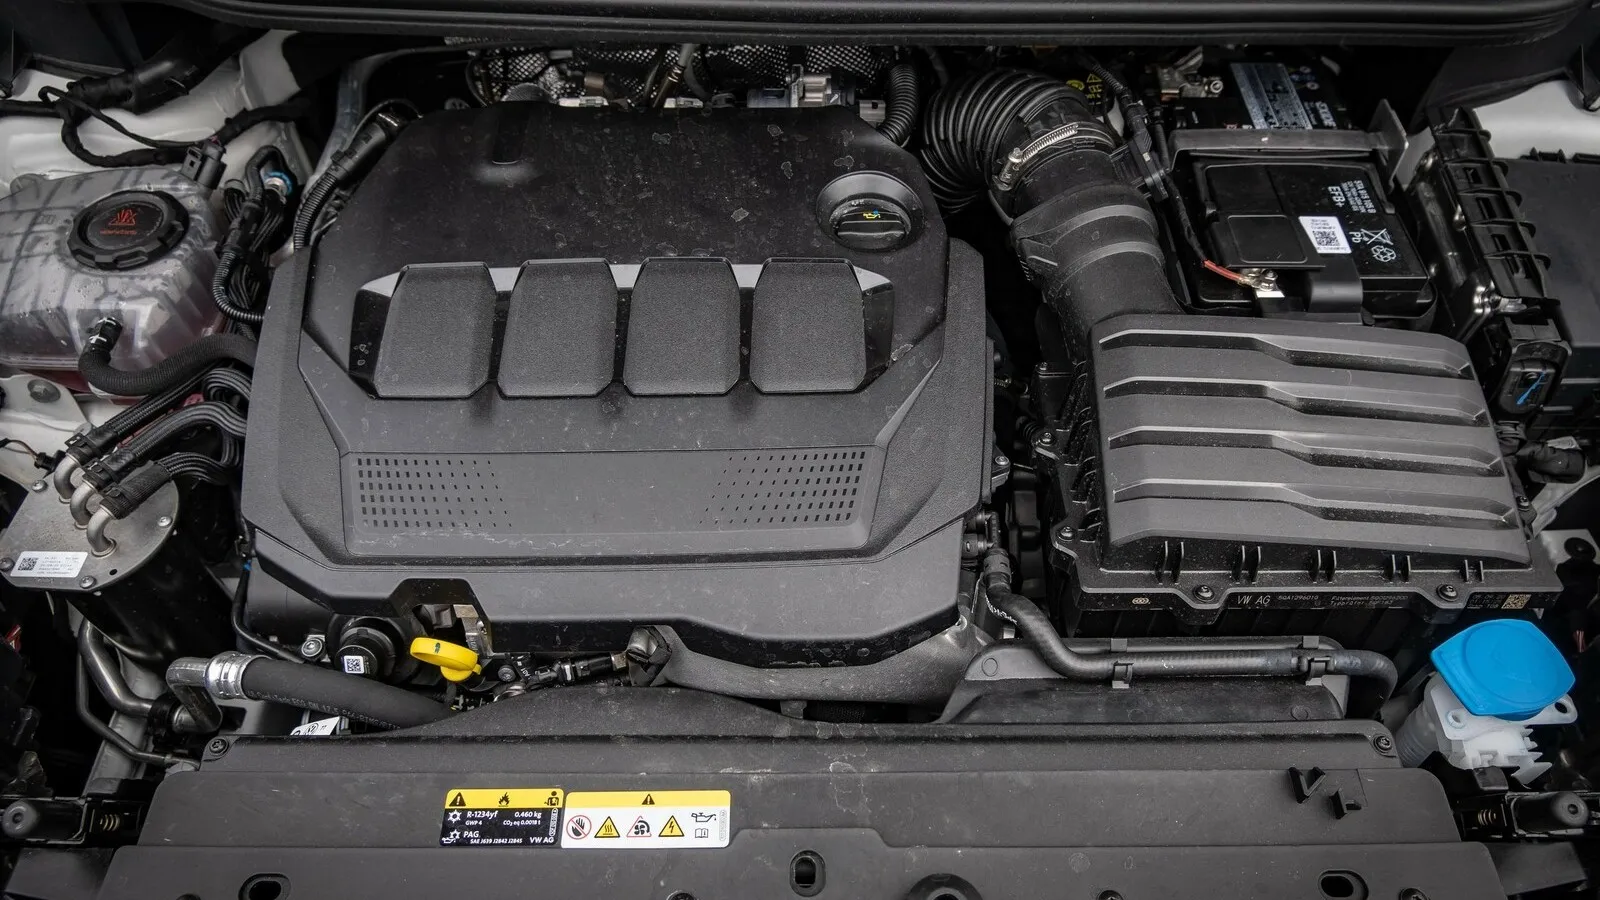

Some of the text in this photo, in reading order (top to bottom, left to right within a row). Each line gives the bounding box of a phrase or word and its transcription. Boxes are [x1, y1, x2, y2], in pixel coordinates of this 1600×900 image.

[1328, 186, 1346, 208] EFB+
[1349, 231, 1362, 243] Pb
[1236, 595, 1271, 605] VW AG
[466, 810, 499, 819] R-1234yf
[534, 811, 542, 819] kg
[463, 830, 480, 838] PAG
[543, 836, 555, 844] AG
